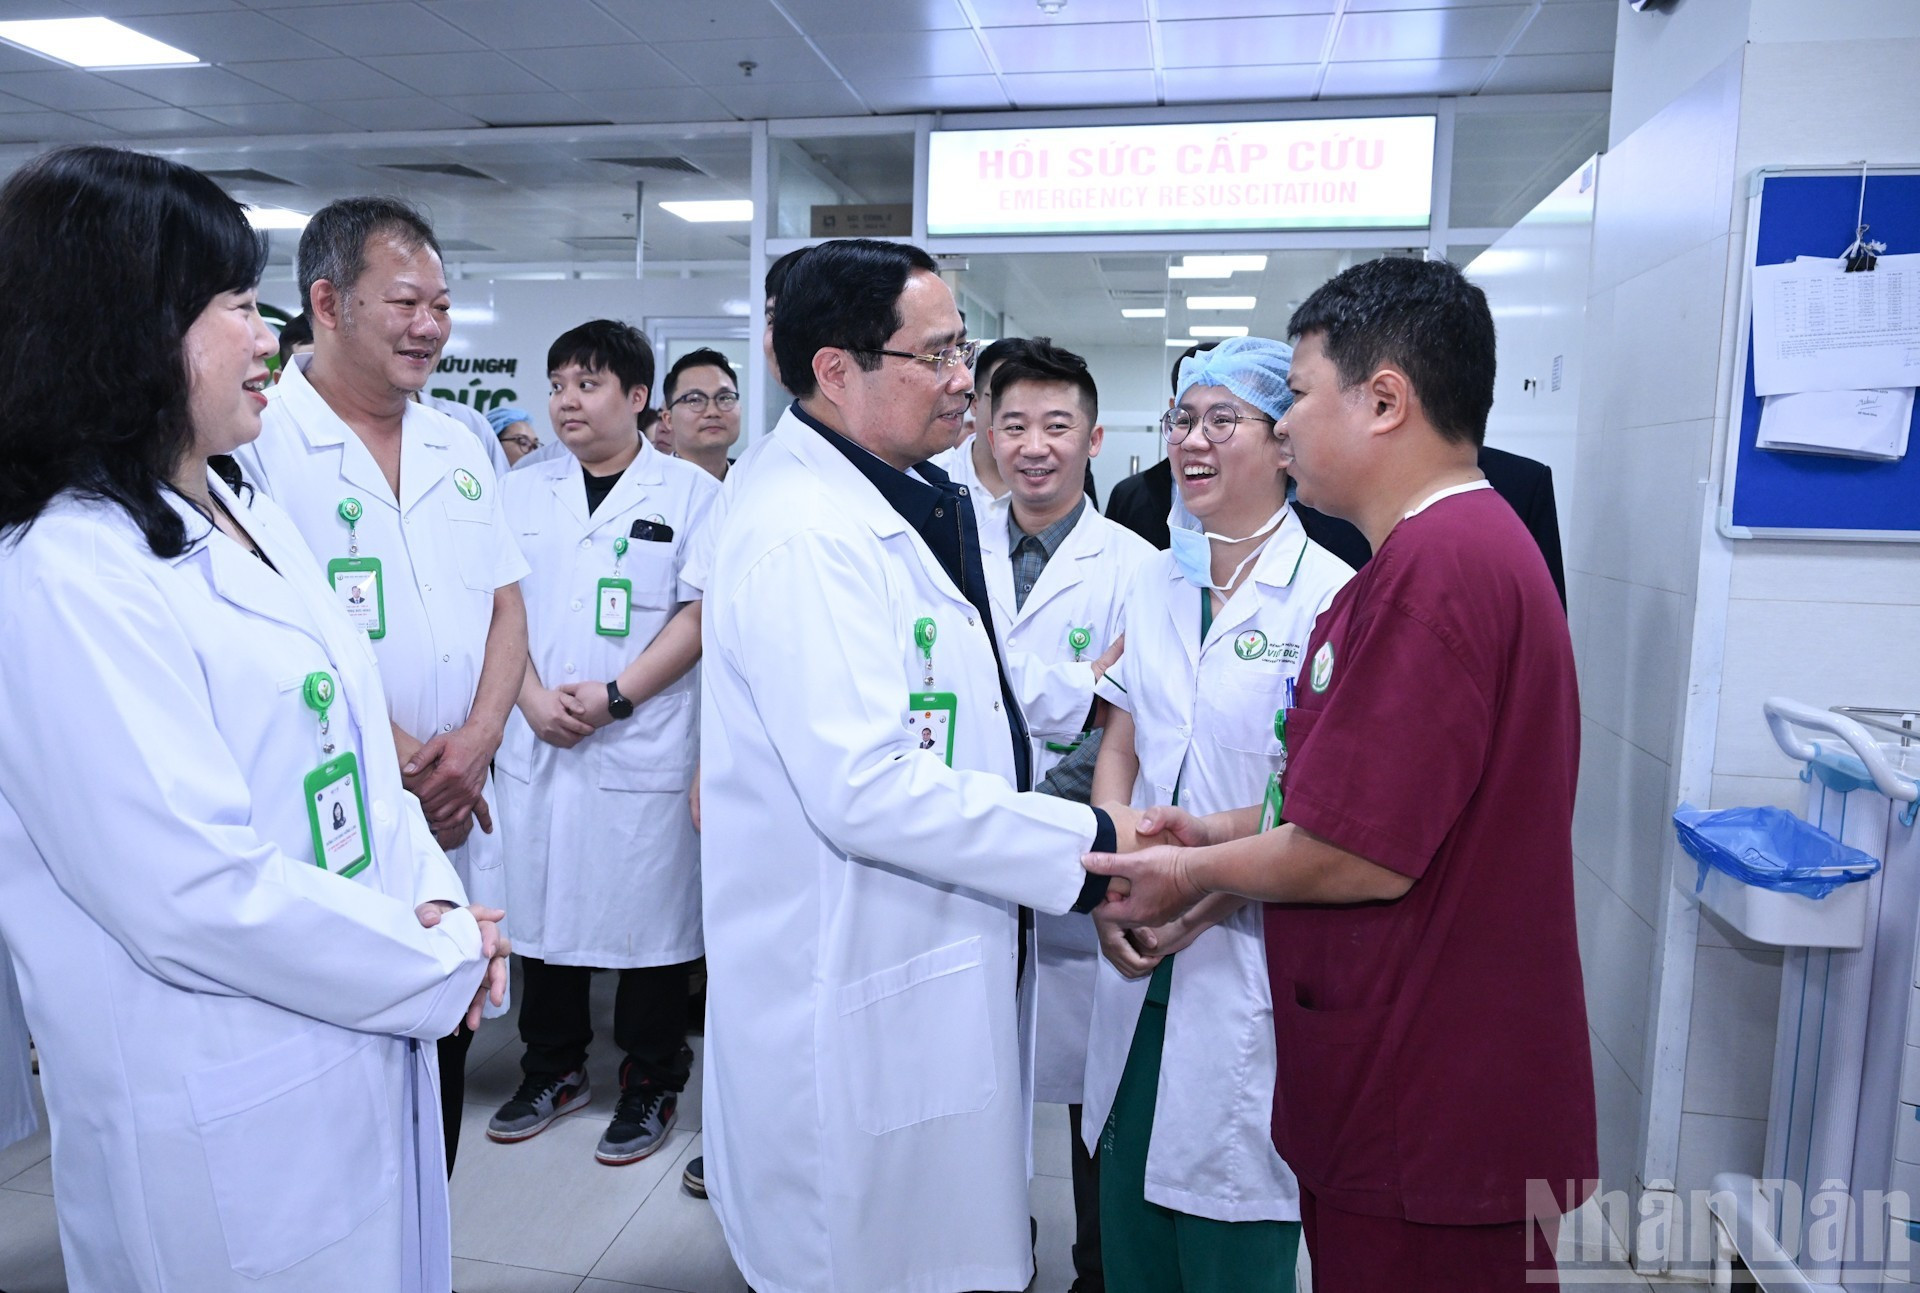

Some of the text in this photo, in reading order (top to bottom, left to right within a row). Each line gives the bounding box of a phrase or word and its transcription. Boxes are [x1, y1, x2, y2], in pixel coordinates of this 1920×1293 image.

[978, 131, 1385, 179] HỒI SỨC CẤP CỨU
[1000, 181, 1357, 210] EMERGENCY RESUSCITATION
[472, 358, 517, 377] NGHỊ
